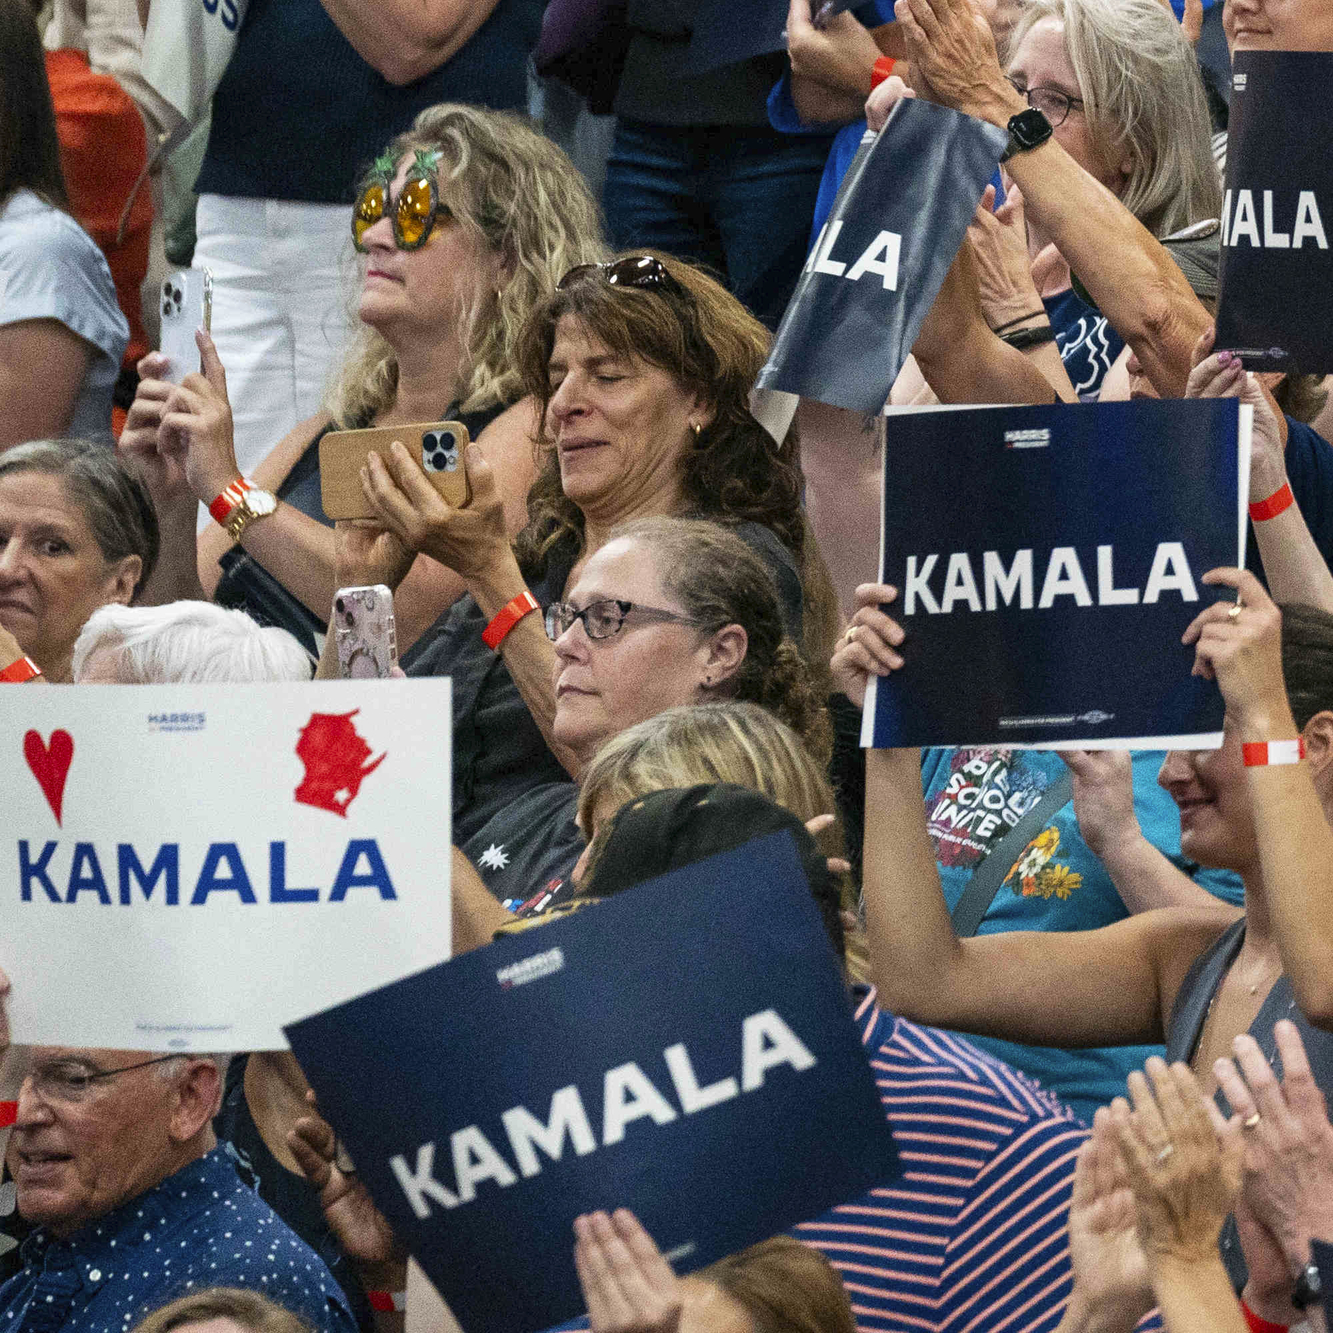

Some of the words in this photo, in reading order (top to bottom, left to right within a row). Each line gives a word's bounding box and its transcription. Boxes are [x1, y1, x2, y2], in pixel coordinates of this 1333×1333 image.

[1223, 188, 1329, 250] ALA
[905, 542, 1199, 616] KAMALA
[17, 837, 398, 907] KAMALA
[390, 1008, 816, 1219] KAMALA
